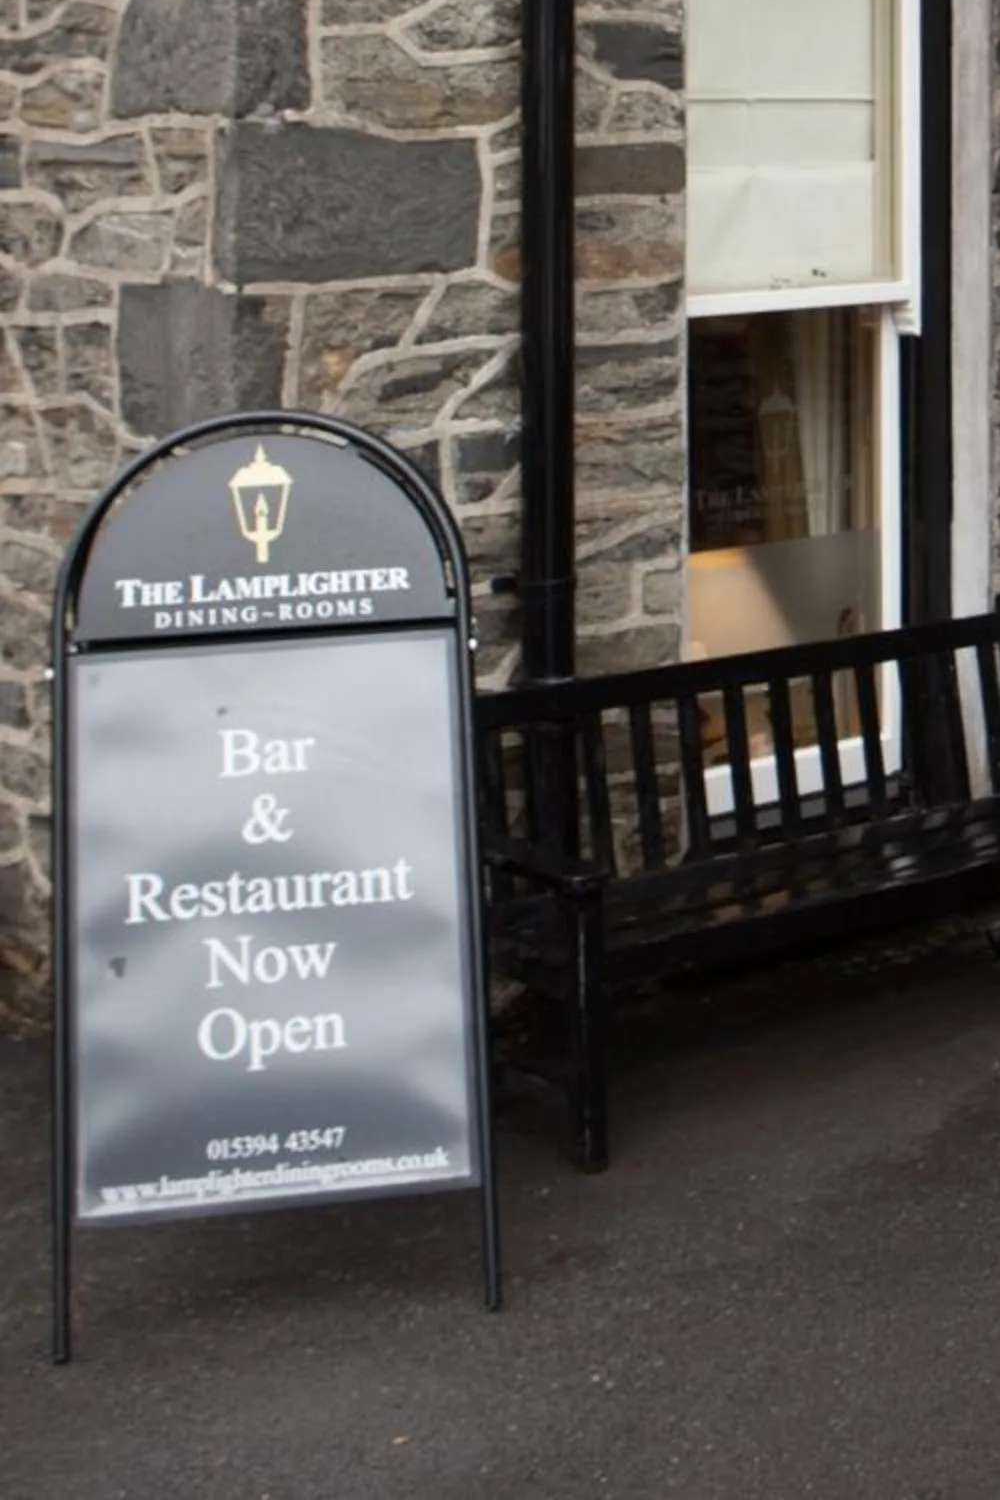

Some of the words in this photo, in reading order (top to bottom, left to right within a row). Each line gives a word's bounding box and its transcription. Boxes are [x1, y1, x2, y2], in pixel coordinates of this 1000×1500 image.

[115, 579, 183, 607] THE
[189, 566, 411, 603] LAMPLIGHTER
[217, 728, 316, 778] Bar
[242, 793, 294, 844] &
[124, 857, 415, 924] Restaurant
[202, 934, 338, 988] Now
[197, 1007, 349, 1073] Open
[207, 1132, 280, 1161] 015394
